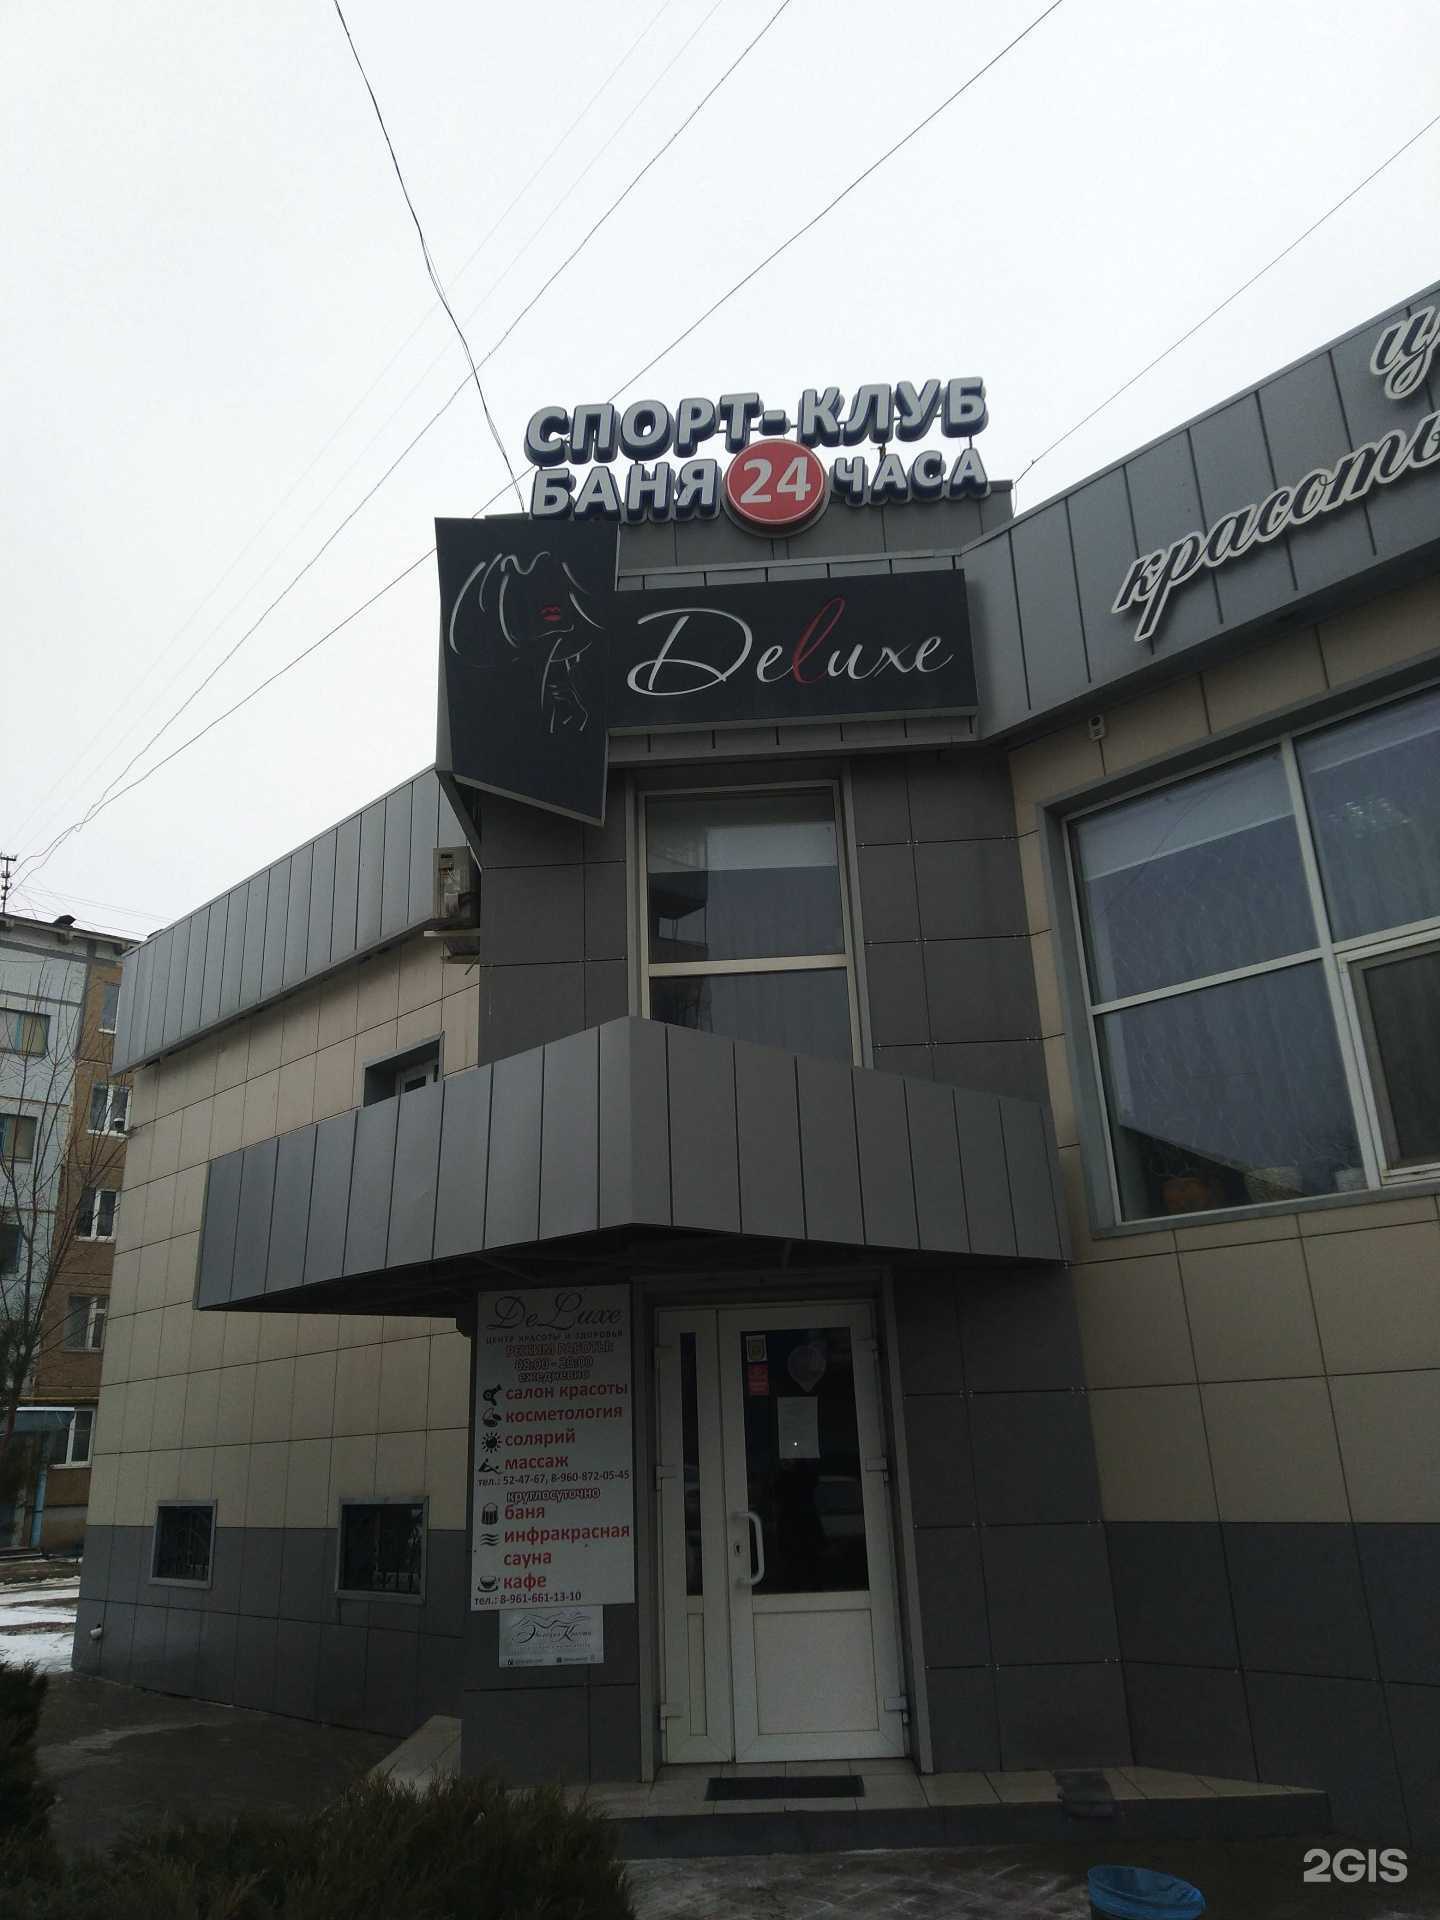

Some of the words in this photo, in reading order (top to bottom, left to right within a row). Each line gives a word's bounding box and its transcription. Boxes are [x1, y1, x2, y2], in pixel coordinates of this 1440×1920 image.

[524, 377, 989, 466] СПОРТ-КЛУБ
[530, 458, 720, 523] БАНЯ
[740, 456, 811, 504] 24
[832, 448, 990, 502] ЧАСА
[626, 595, 954, 696] Deluxe
[486, 1335, 514, 1345] ЦЕНТР
[518, 1332, 561, 1343] КРАСОТЫ
[564, 1332, 571, 1340] И
[575, 1329, 623, 1340] ЗДОРОВЬЯ
[505, 1386, 554, 1400] салон
[559, 1383, 628, 1401] красоты
[505, 1405, 623, 1423] косметология
[505, 1428, 576, 1448] солярий
[505, 1455, 569, 1471] массаж
[506, 1487, 601, 1504] круглосуточно
[504, 1504, 545, 1520] баня
[504, 1524, 630, 1545] инфракрасная
[503, 1551, 552, 1567] сауна
[503, 1572, 547, 1591] кафе
[500, 1591, 582, 1604] 8-961-661-13-10
